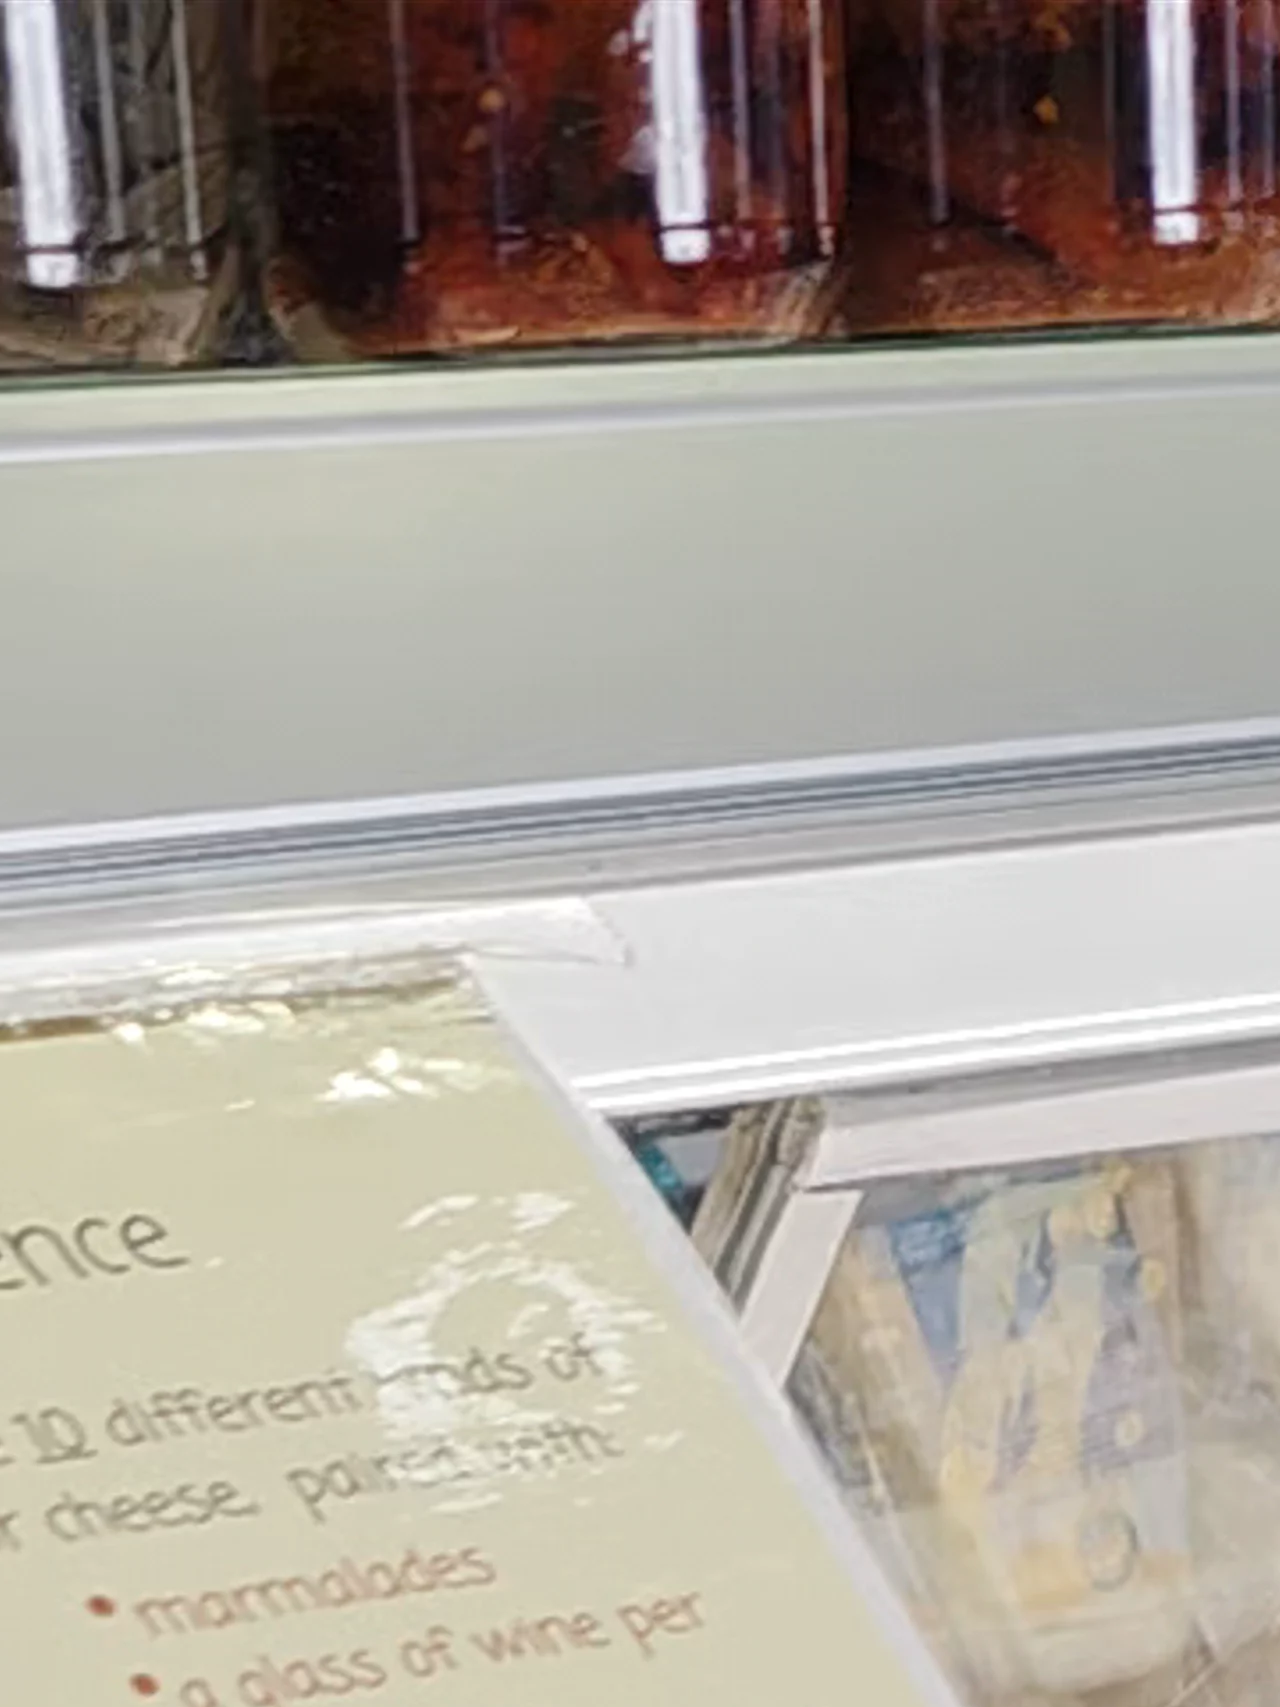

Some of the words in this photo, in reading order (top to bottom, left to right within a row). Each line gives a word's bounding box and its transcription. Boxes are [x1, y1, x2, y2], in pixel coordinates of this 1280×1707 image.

[105, 1369, 363, 1446] different
[133, 1545, 497, 1641] marmalades
[400, 1626, 461, 1678] of
[471, 1605, 611, 1666] wine
[616, 1591, 706, 1666] per
